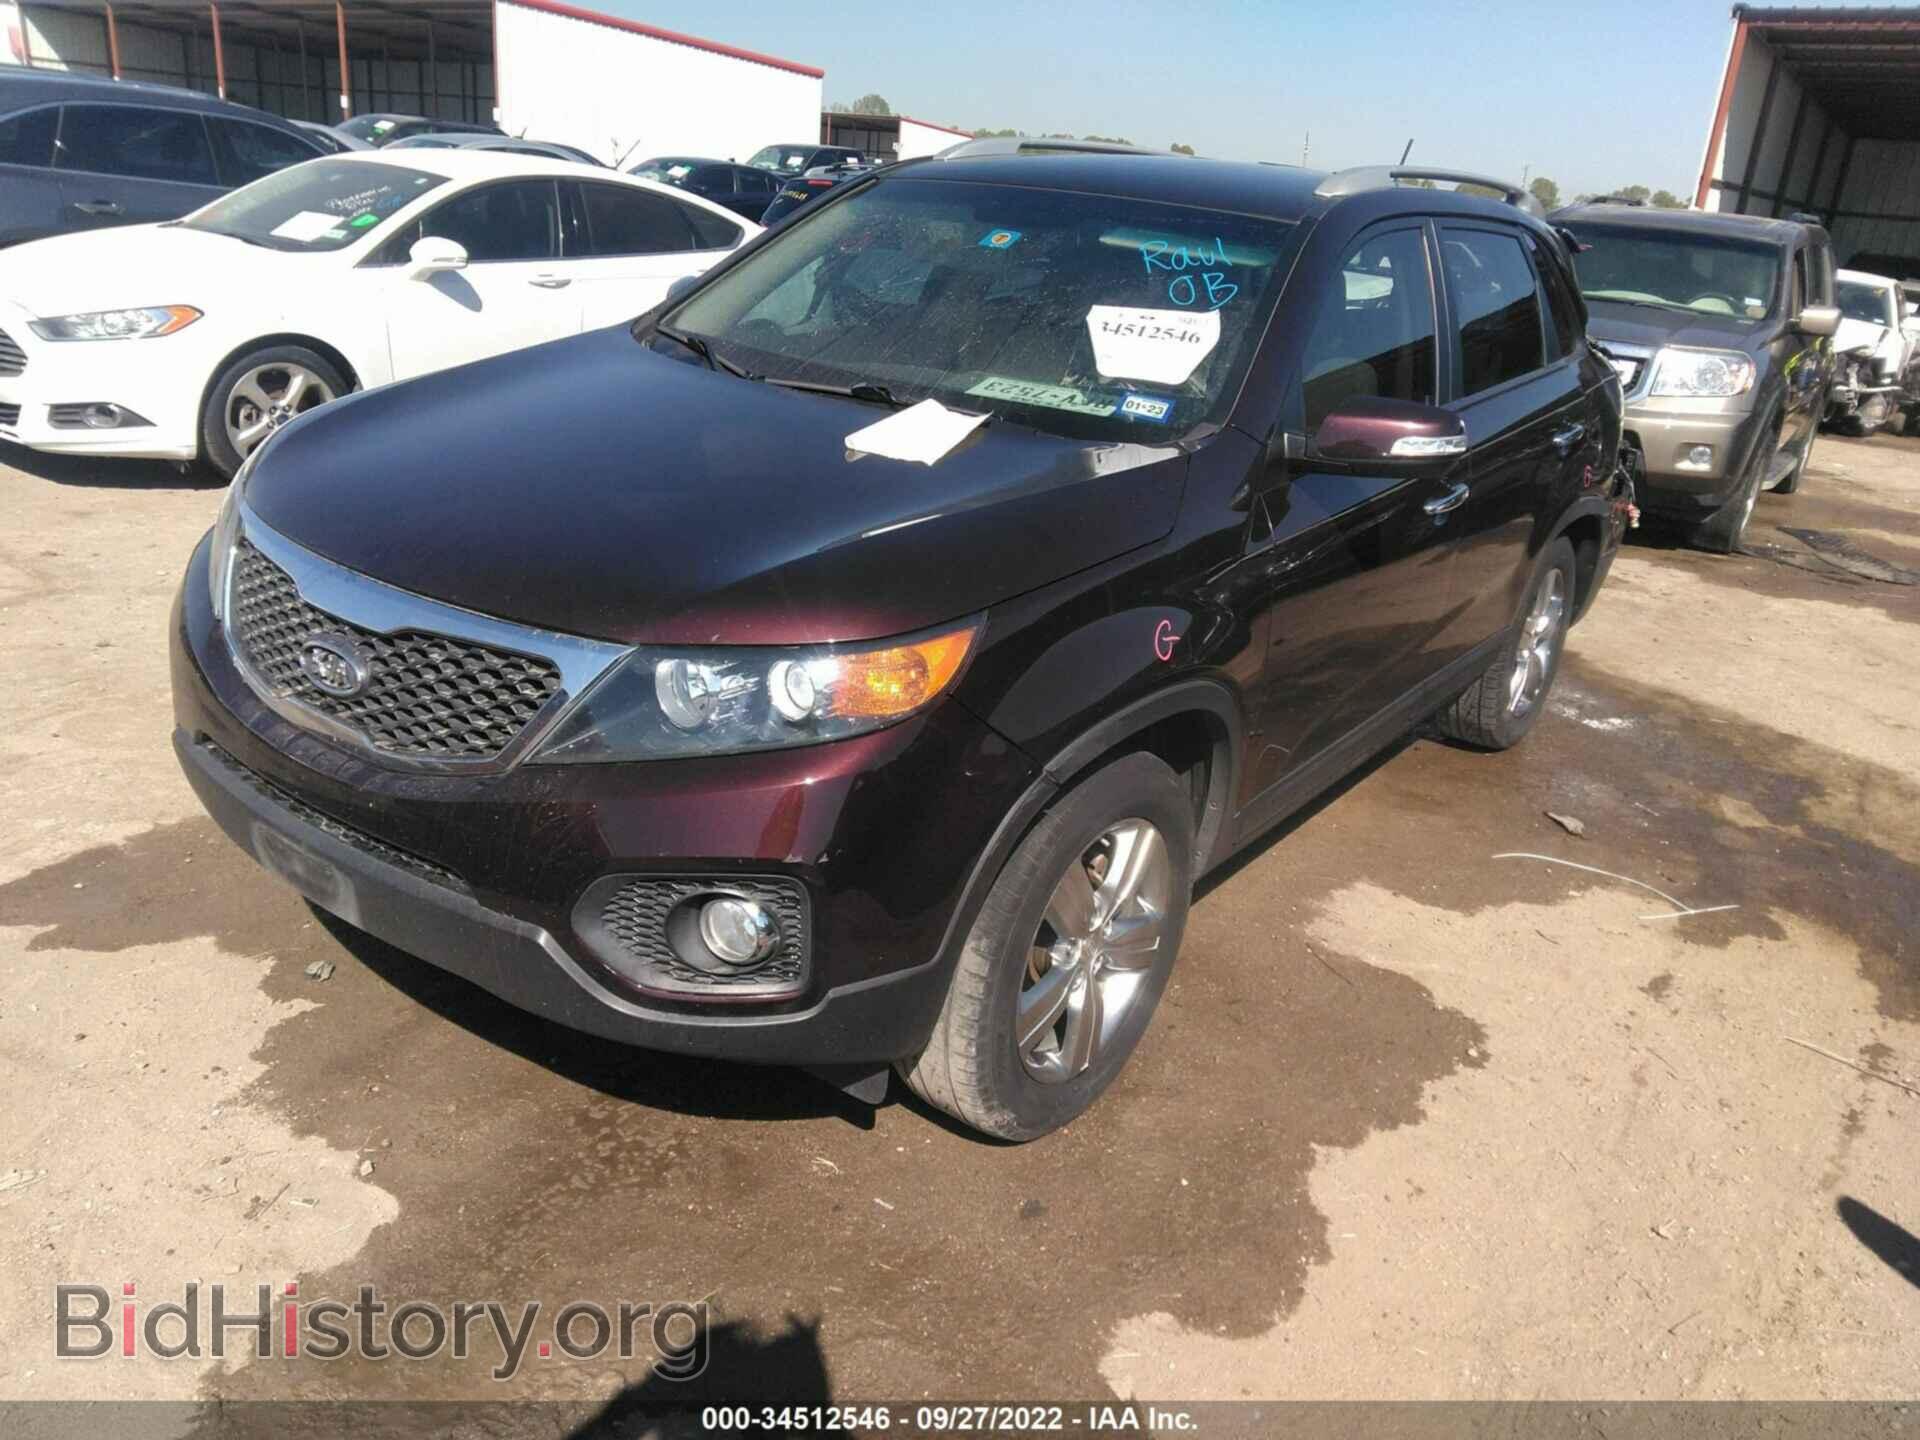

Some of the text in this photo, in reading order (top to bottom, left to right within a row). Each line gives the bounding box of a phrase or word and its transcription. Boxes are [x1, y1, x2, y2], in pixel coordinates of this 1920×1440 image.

[1140, 237, 1233, 274] Raul
[1102, 321, 1201, 344] 34512546
[1154, 619, 1181, 661] G
